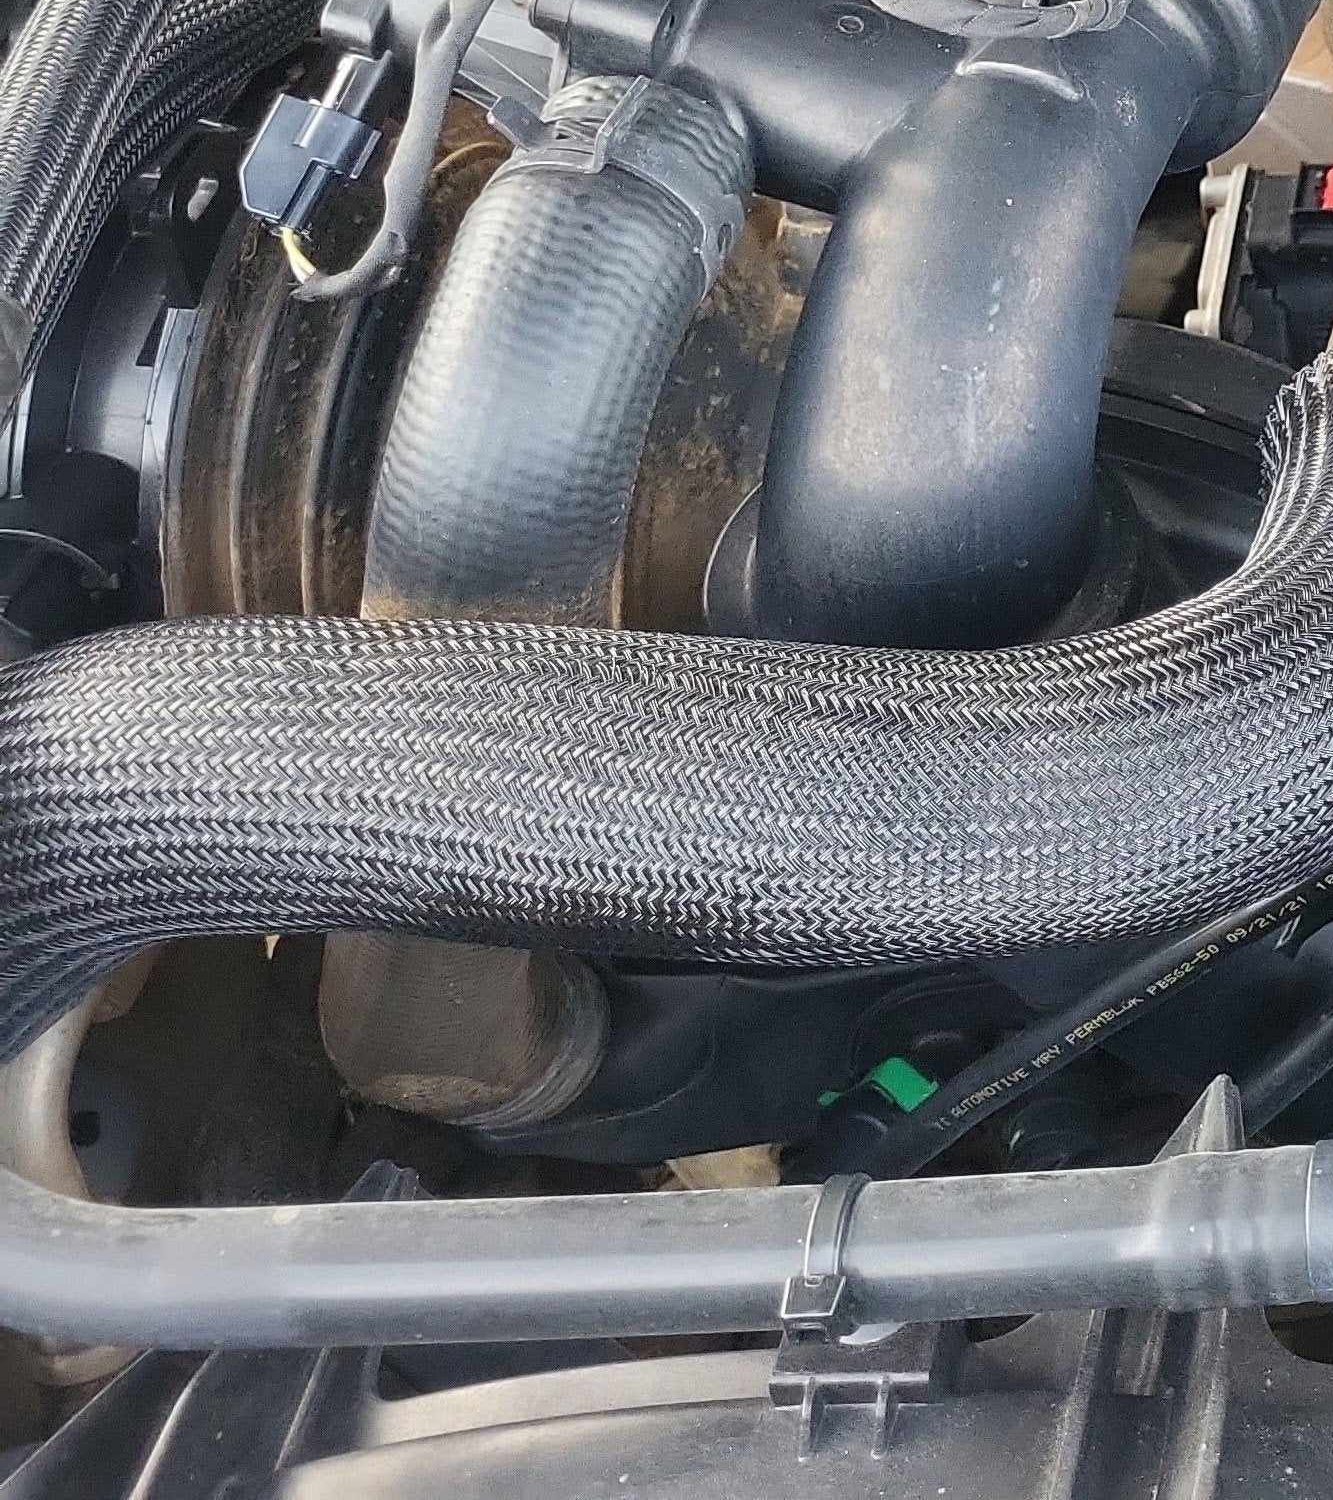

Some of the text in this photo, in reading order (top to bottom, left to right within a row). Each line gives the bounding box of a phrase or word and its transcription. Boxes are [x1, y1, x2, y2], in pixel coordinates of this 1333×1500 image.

[951, 1067, 1031, 1118] AUTOMOTIVE
[1031, 1044, 1061, 1070] MRY
[1065, 997, 1145, 1046] PERMBLOK
[1146, 943, 1220, 996] PB562-50
[1225, 895, 1309, 943] 09/21/21
